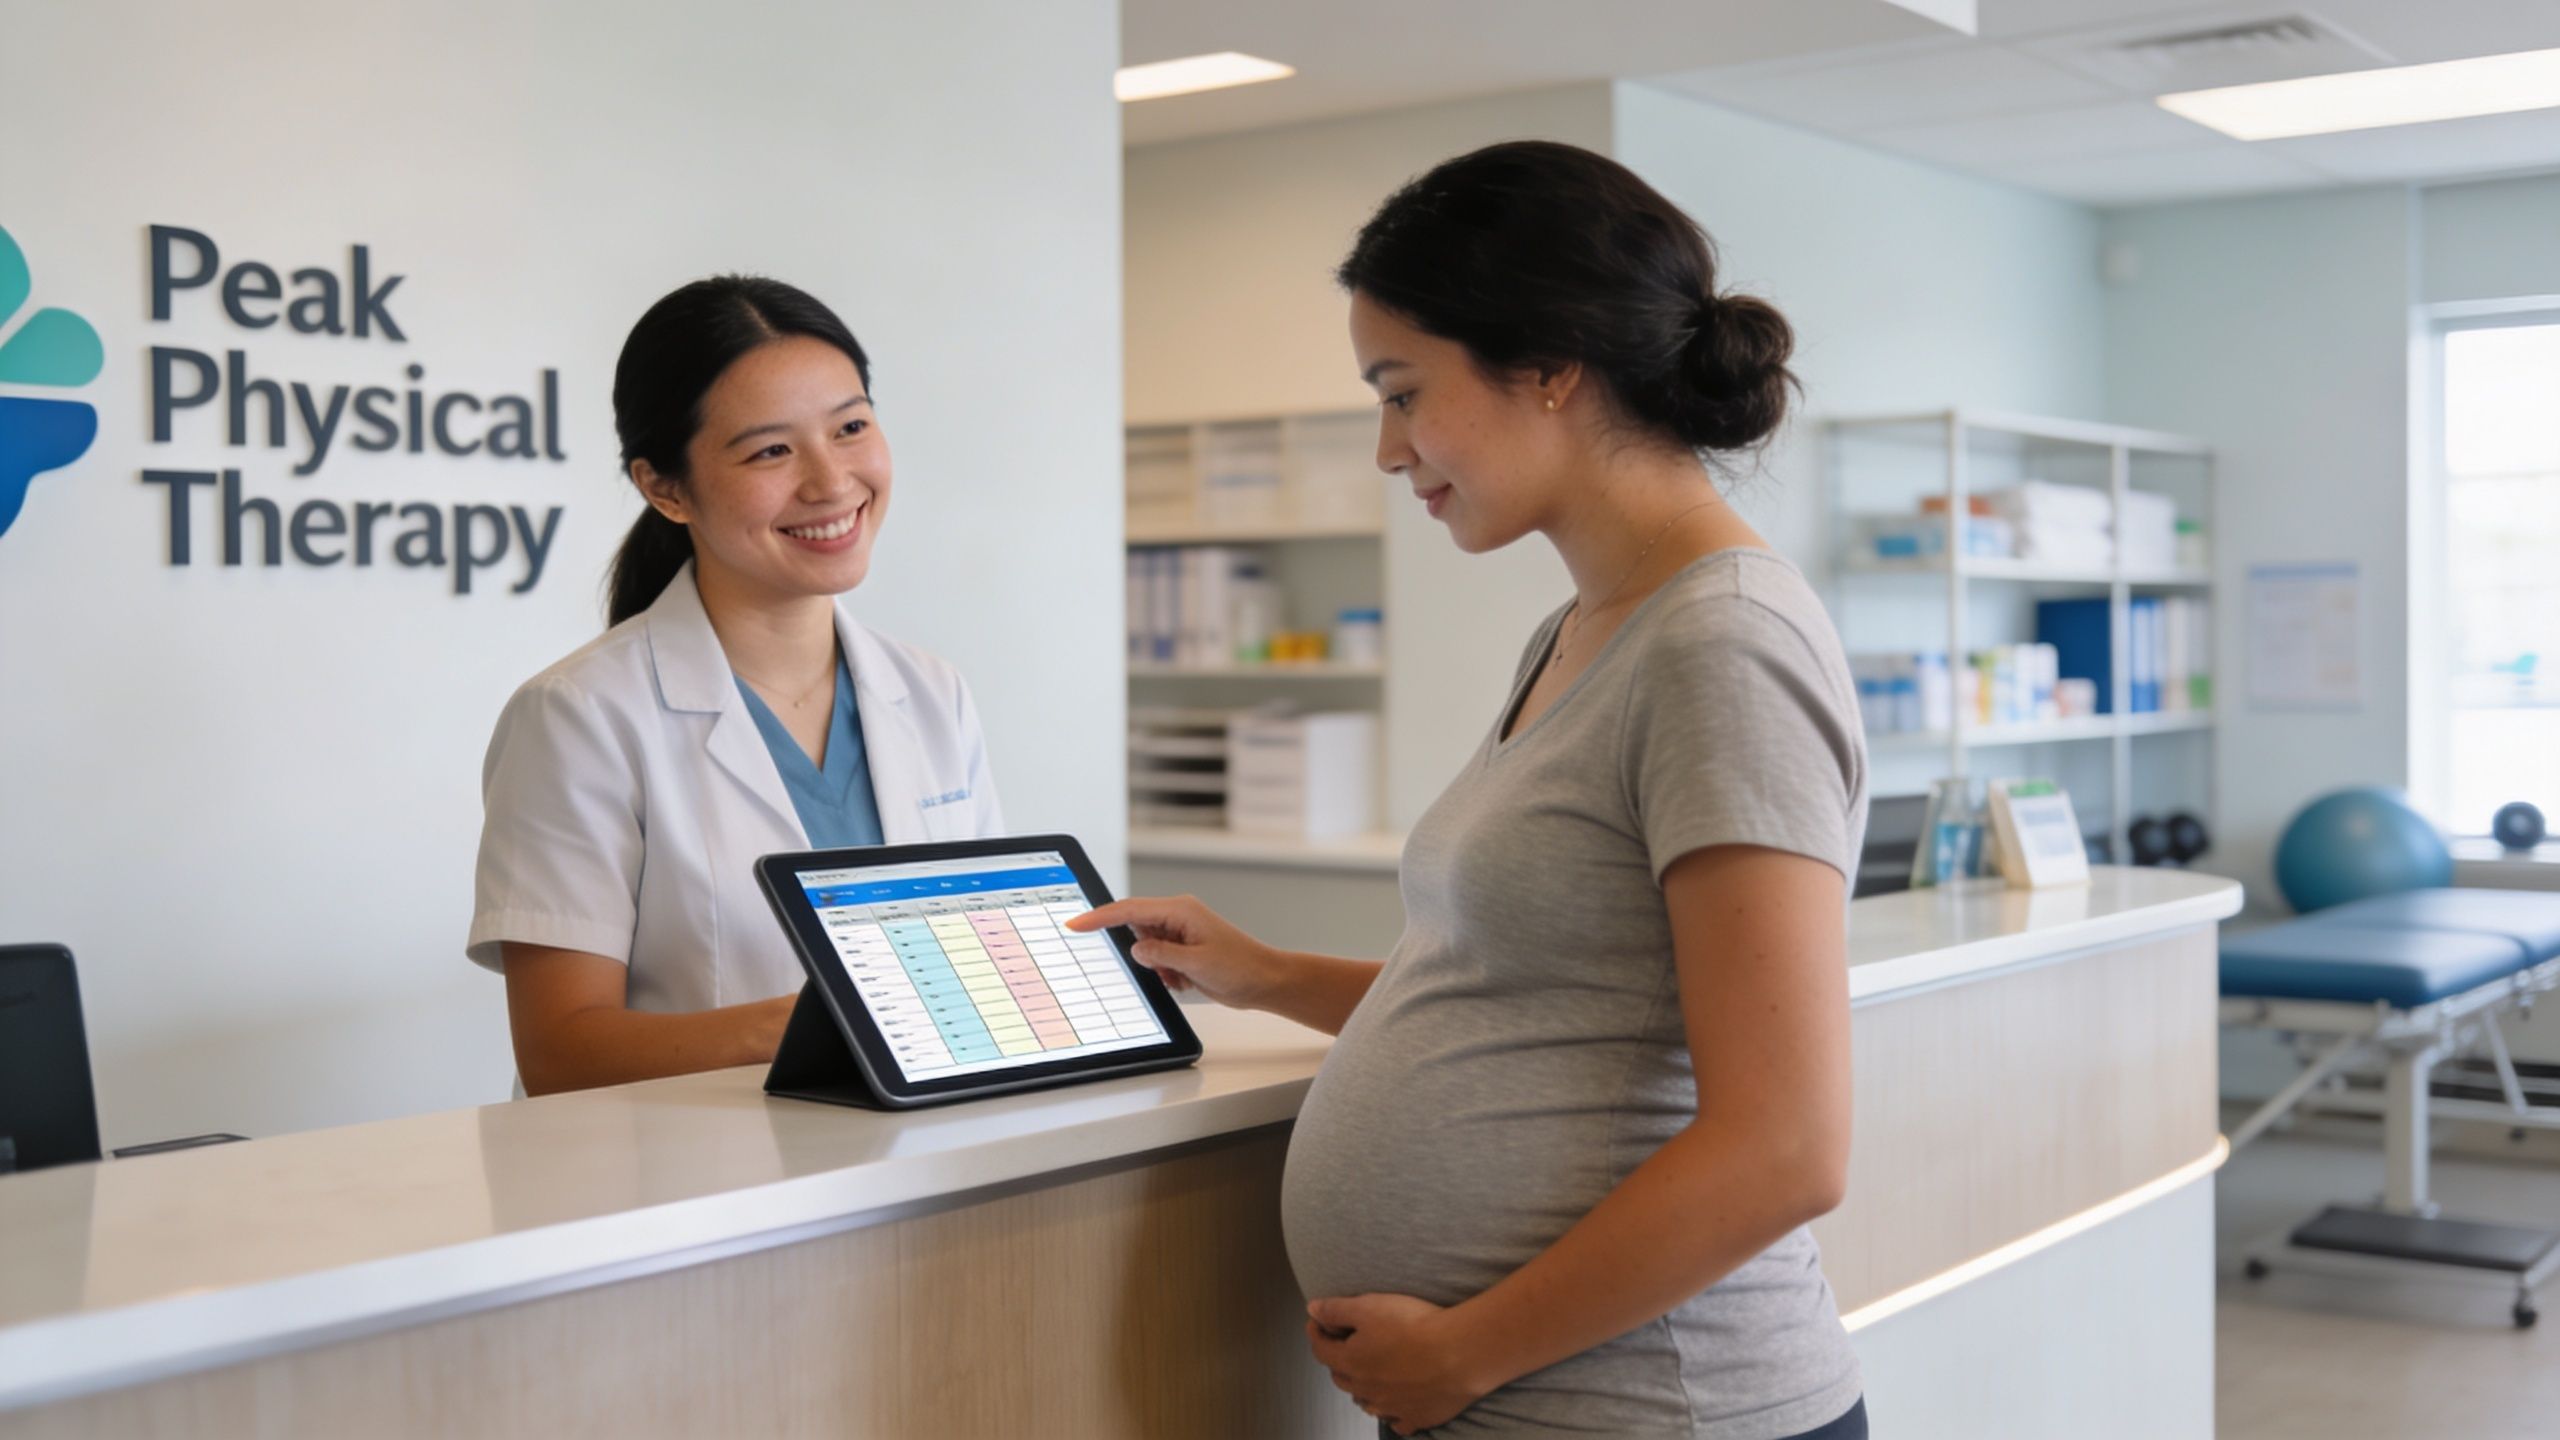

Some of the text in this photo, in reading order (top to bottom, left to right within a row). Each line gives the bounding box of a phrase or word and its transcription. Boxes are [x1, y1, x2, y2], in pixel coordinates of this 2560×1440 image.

[147, 223, 408, 342] Peak
[148, 345, 567, 477] Physical
[141, 468, 565, 596] Therapy
